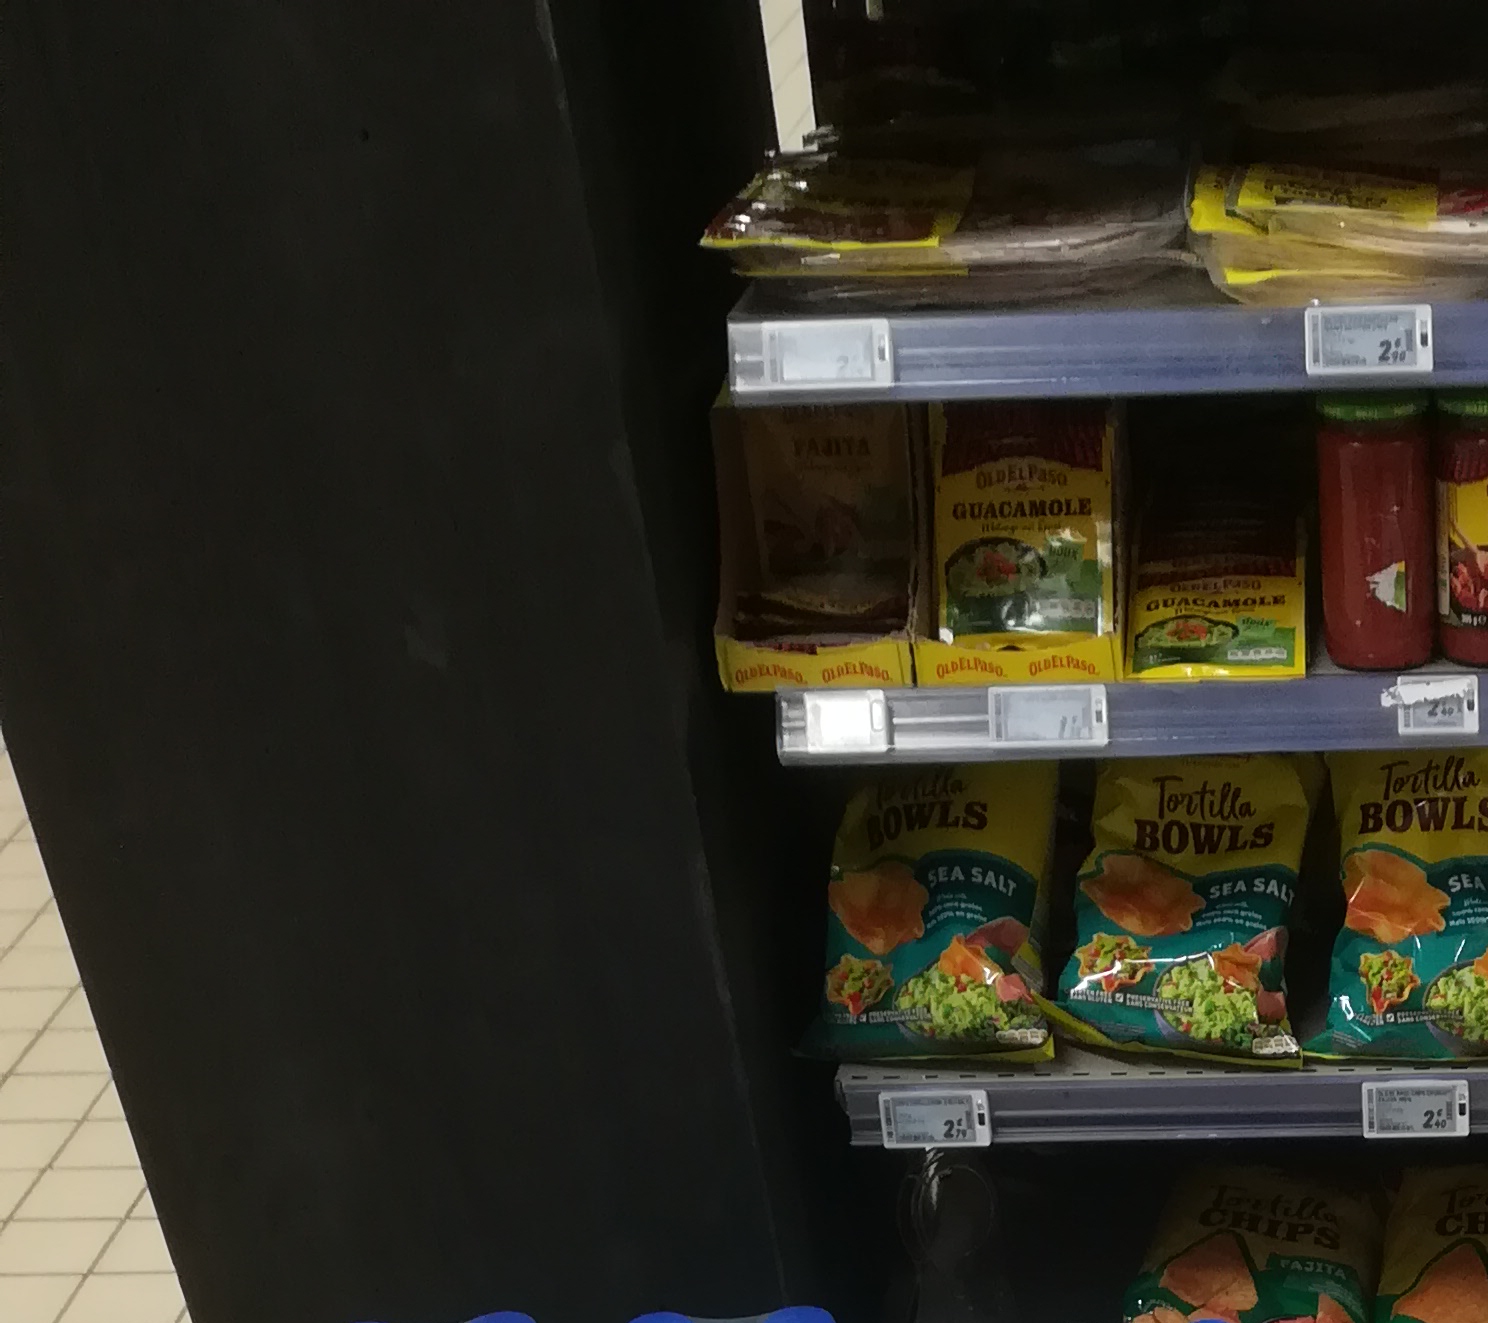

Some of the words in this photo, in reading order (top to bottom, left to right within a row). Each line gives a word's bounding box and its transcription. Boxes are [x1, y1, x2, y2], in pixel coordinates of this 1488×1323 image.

[952, 497, 1092, 520] GUACAMOLE
[1146, 595, 1285, 612] GUACAMOLE
[1380, 755, 1480, 801] Tortilla
[1152, 775, 1257, 822] Tortilla
[866, 801, 989, 850] BOWLS
[1135, 819, 1275, 855] BOWLS
[927, 867, 965, 887] SEA
[972, 868, 1017, 897] SALT
[1209, 880, 1246, 900] SEA
[1254, 877, 1295, 904] SALT
[1448, 873, 1486, 894] SEA
[1199, 1207, 1341, 1251] CHIPS
[1280, 1257, 1348, 1281] FAJITA
